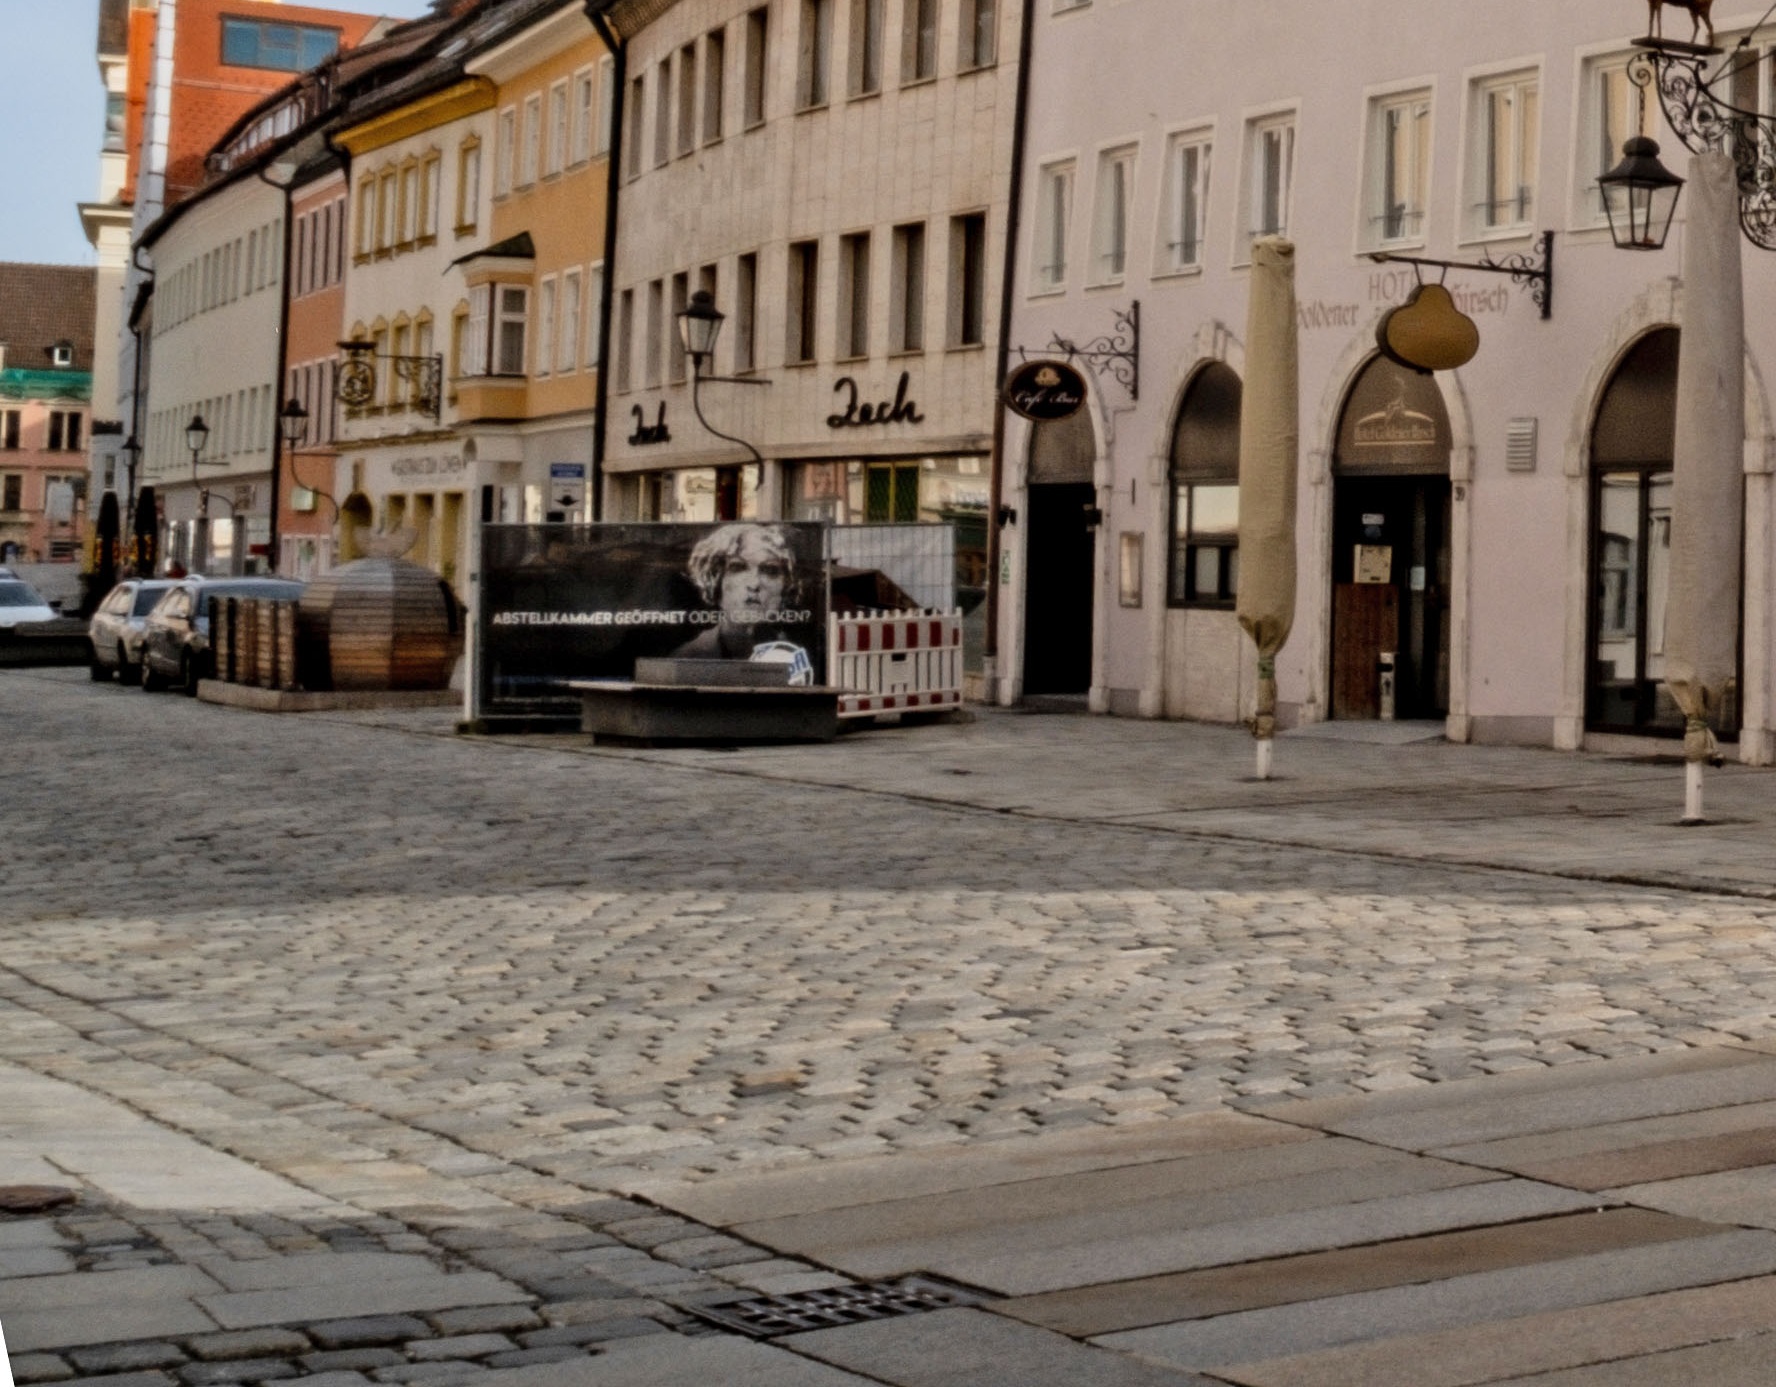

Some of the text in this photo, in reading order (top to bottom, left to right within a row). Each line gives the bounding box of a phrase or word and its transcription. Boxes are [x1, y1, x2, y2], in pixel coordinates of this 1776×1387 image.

[1368, 269, 1424, 301] HOT
[1296, 299, 1360, 330] oldener
[493, 611, 612, 626] ABSTELLKAMMER
[615, 608, 686, 625] GEÖFFNET
[689, 610, 728, 624] ODER
